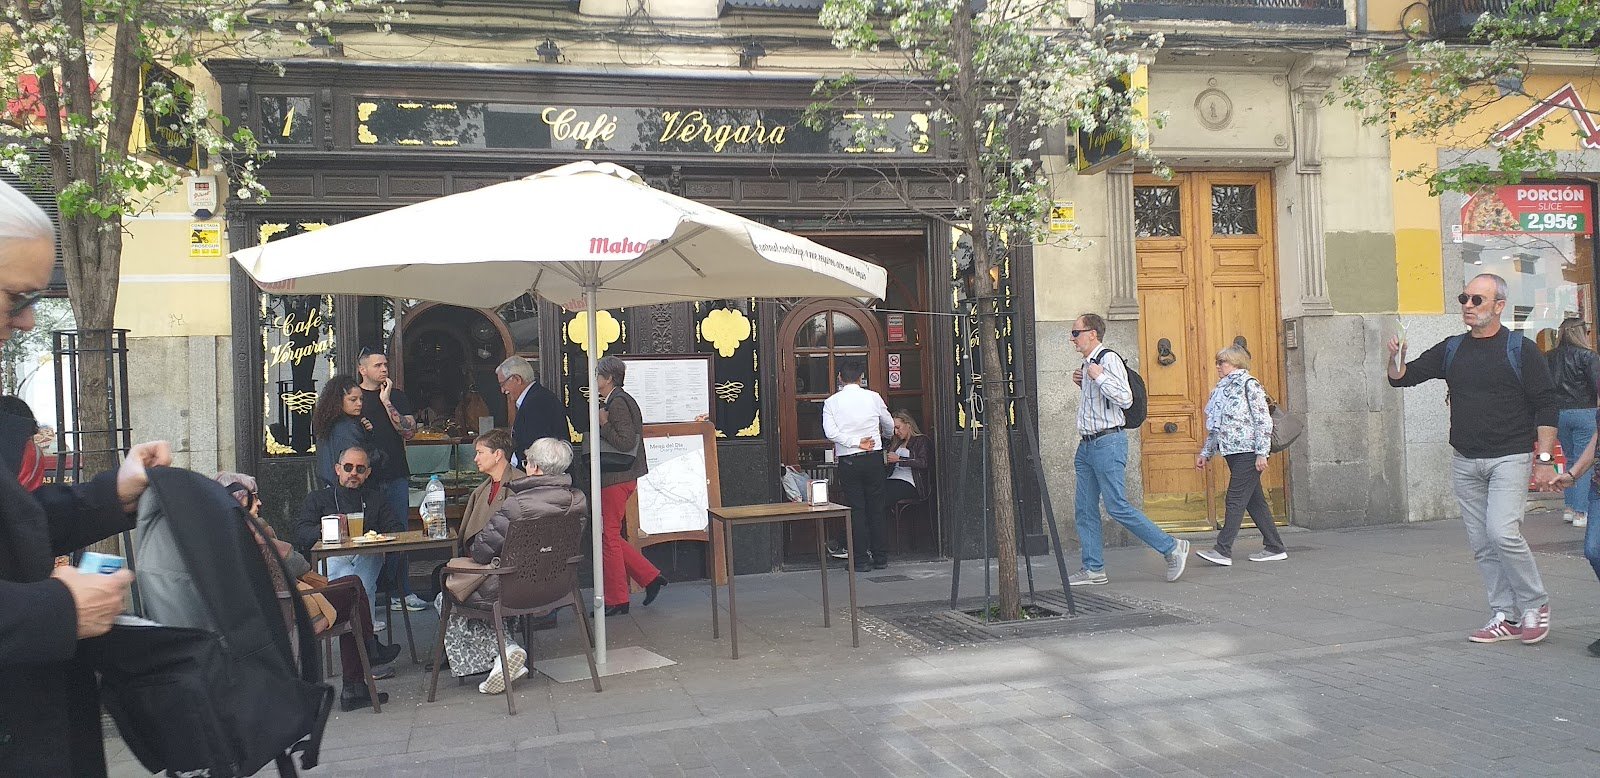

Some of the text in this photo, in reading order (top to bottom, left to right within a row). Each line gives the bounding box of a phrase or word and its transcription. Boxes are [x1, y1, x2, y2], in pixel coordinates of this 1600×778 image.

[282, 105, 295, 137] 1
[541, 107, 786, 153] Café Vergara
[1517, 186, 1585, 201] PORCIÓN
[1538, 202, 1563, 211] SLICE
[1527, 213, 1578, 231] 2,95€
[273, 308, 322, 337] Café
[270, 340, 329, 367] Vergara
